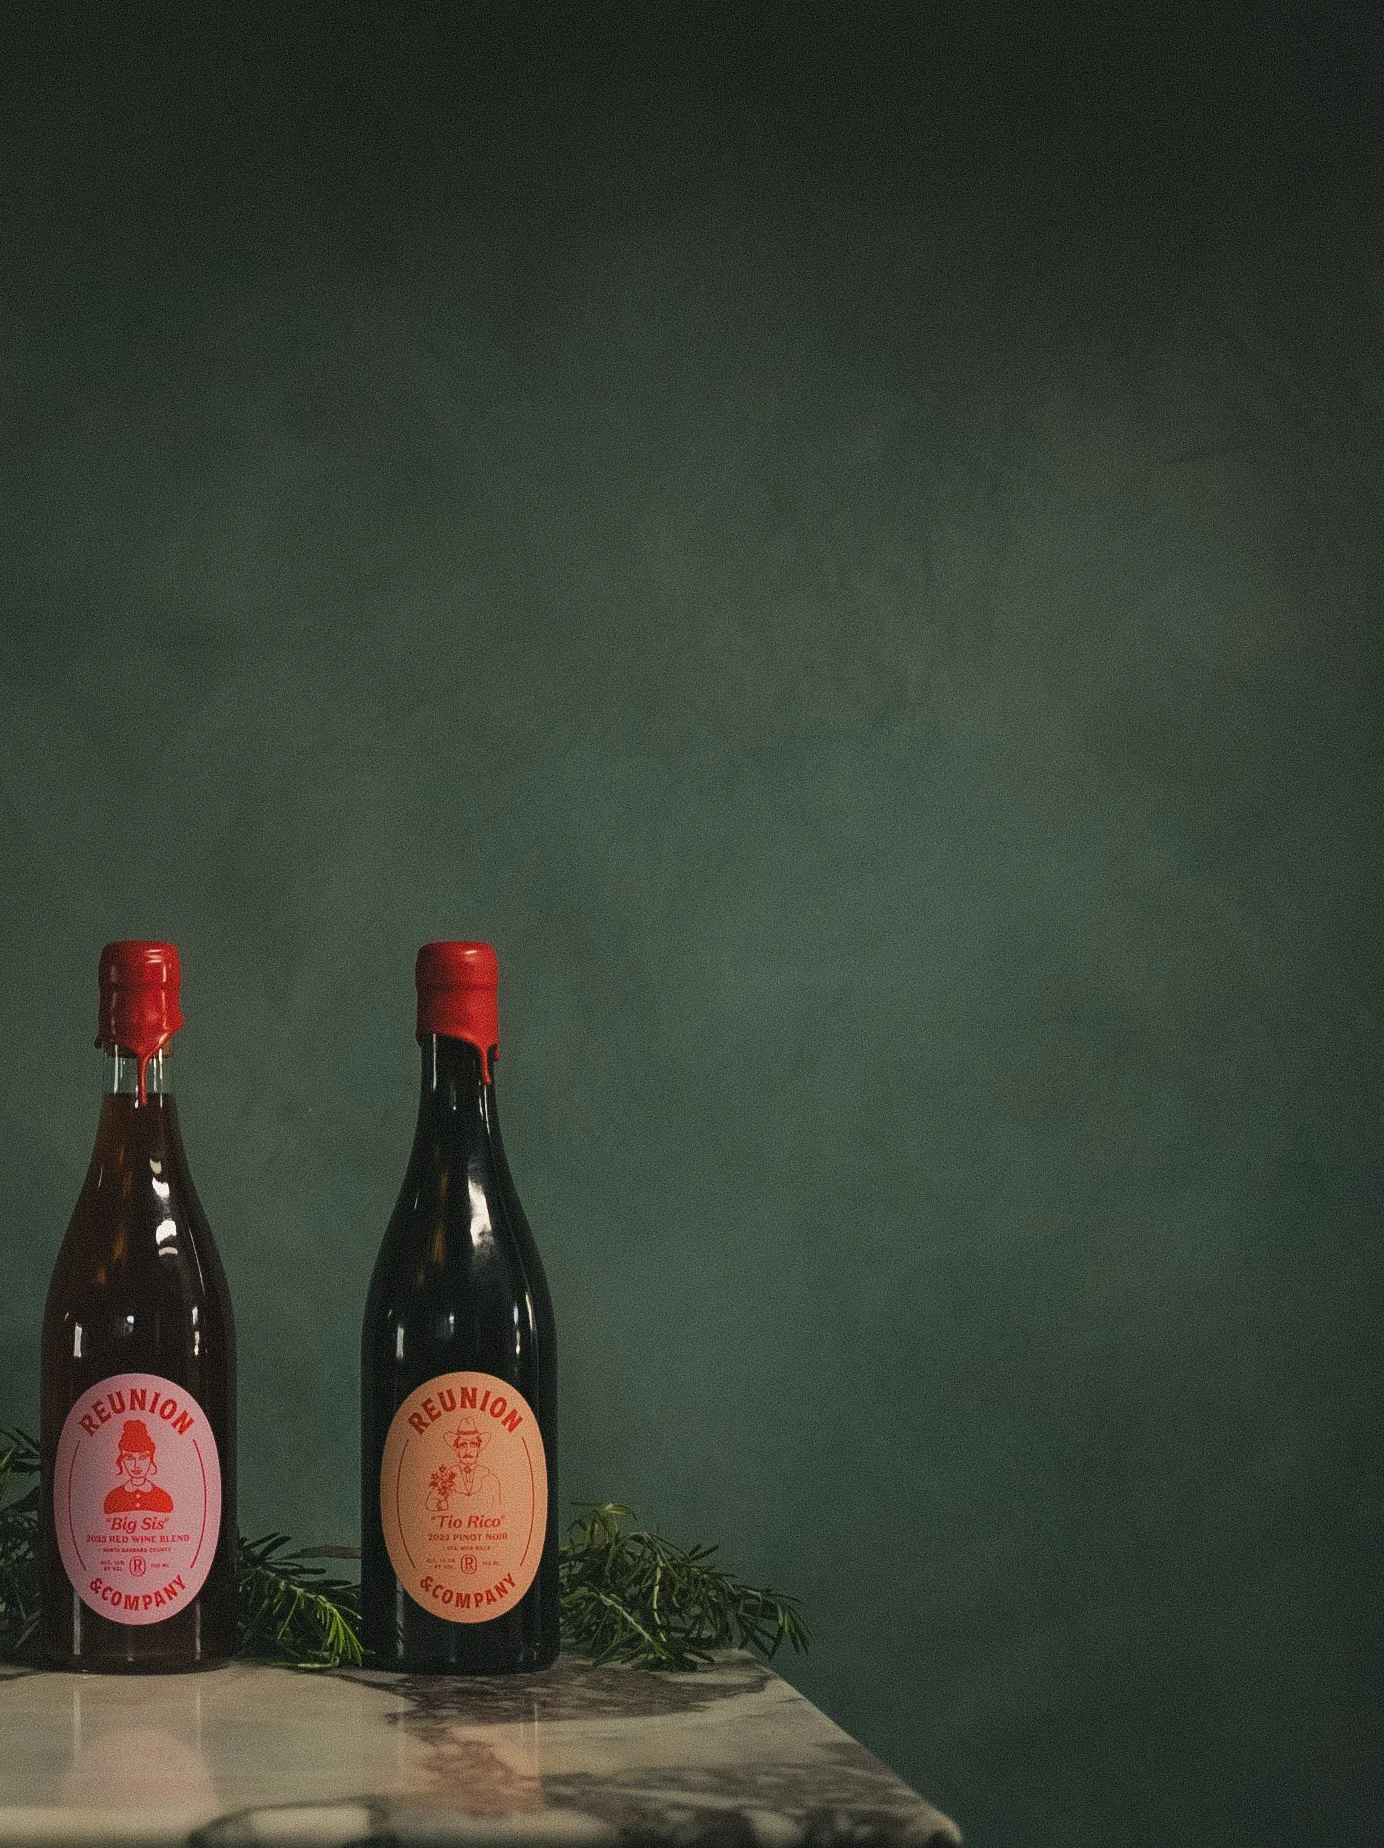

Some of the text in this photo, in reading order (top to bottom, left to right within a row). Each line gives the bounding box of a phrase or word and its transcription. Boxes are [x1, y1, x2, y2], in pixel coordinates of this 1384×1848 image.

[79, 1388, 194, 1437] REUNION
[408, 1387, 523, 1435] REUNION
[453, 1533, 482, 1541] PINOT
[89, 1574, 187, 1611] &COMPANY
[419, 1573, 517, 1609] &COMPANY
